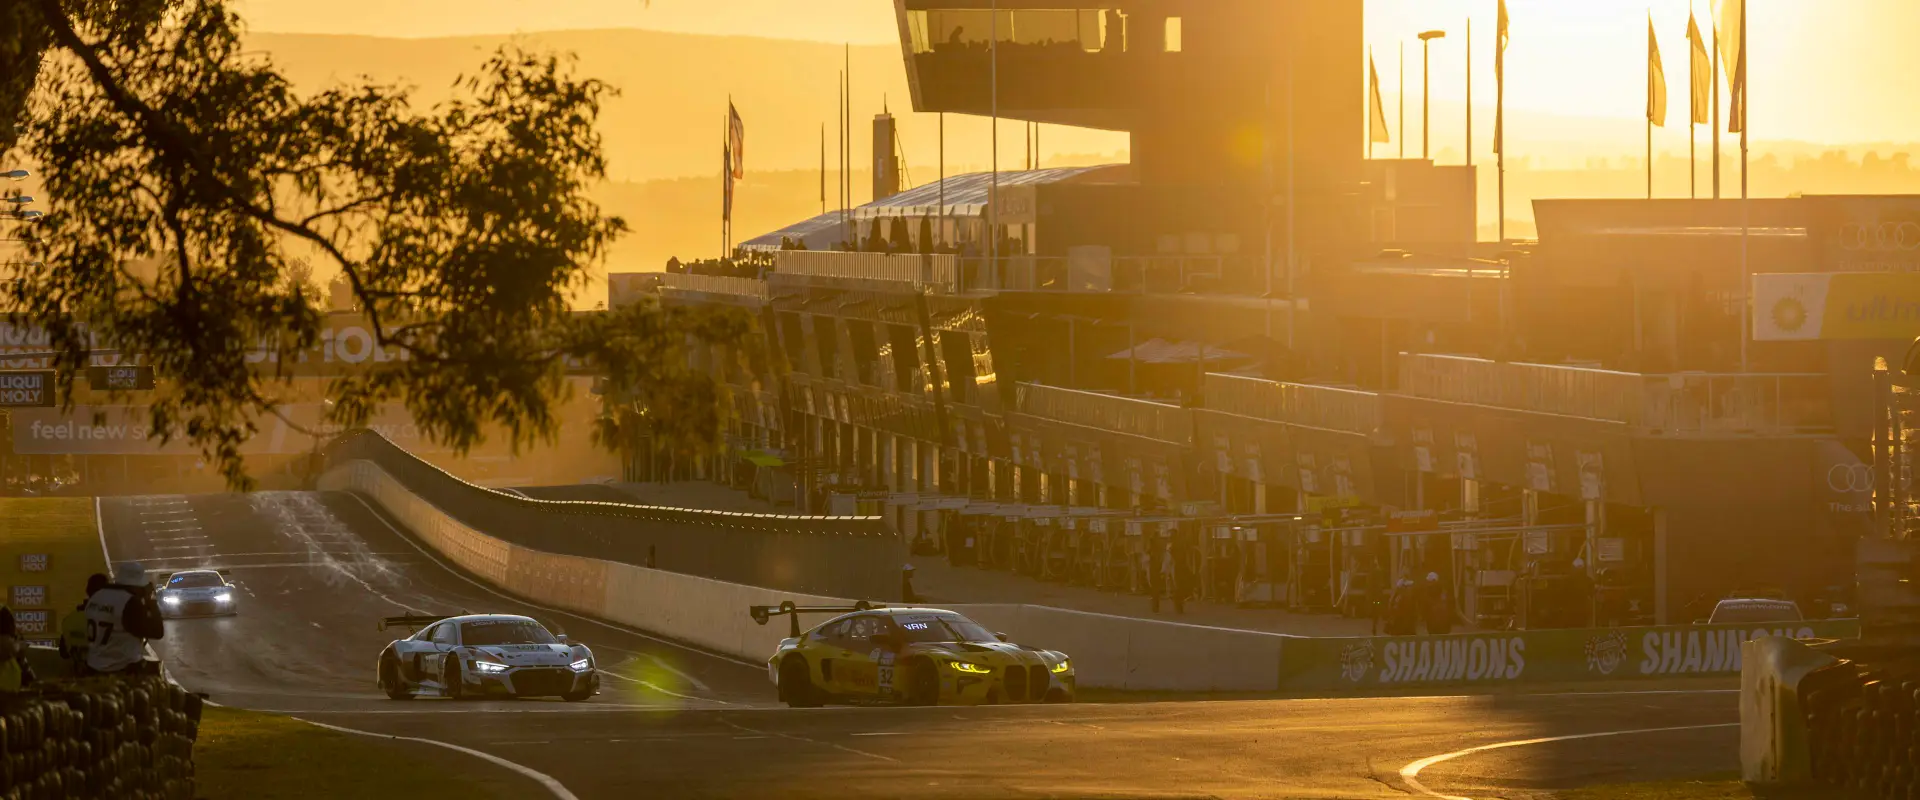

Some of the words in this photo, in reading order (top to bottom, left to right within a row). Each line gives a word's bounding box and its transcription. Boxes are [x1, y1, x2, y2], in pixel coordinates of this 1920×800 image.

[1, 376, 41, 389] LIQUI
[1, 390, 42, 402] MOLY
[31, 420, 75, 440] feel
[78, 425, 127, 440] new
[1828, 502, 1853, 512] The
[14, 587, 44, 596] LIQUI
[15, 597, 43, 605] MOLY
[16, 611, 47, 621] LIQUI
[15, 622, 45, 632] MOLY
[1379, 637, 1526, 683] SHANNONS
[880, 669, 893, 684] 32
